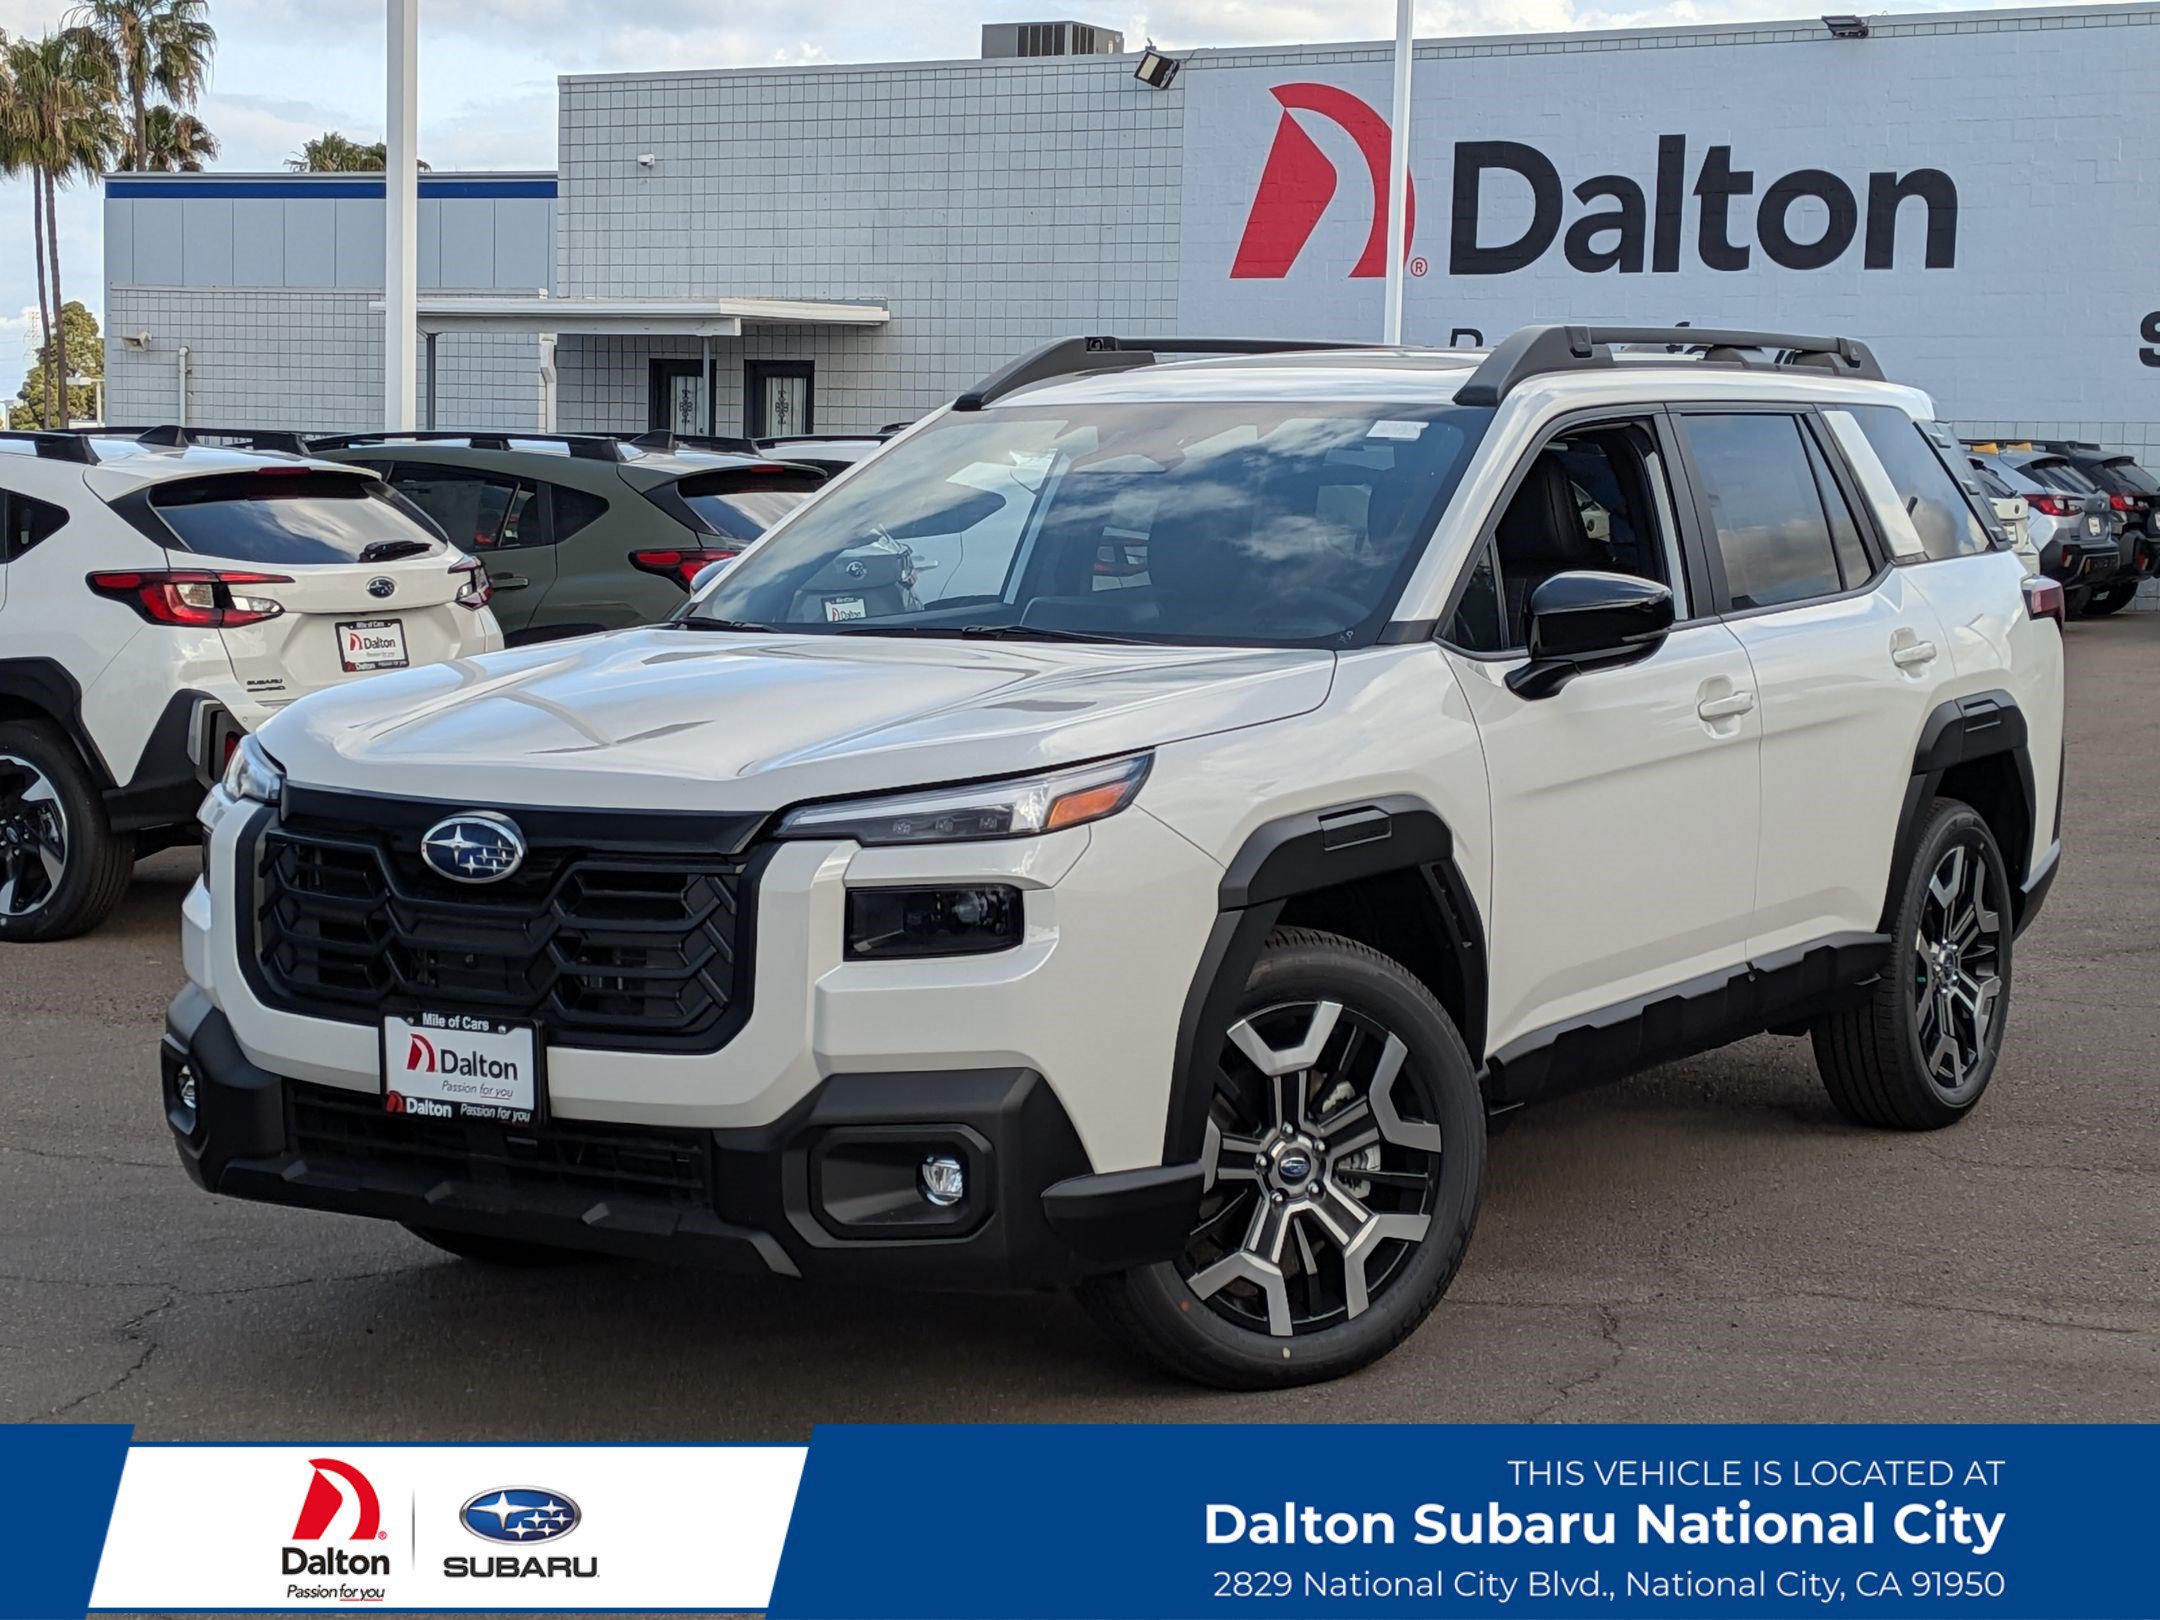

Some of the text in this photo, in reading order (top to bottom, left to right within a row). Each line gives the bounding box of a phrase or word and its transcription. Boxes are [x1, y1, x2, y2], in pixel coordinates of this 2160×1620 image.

[1449, 134, 1958, 275] Dalton
[363, 636, 396, 649] Dalton
[422, 1012, 489, 1031] Mile of Cars
[440, 1048, 518, 1081] Dalton
[441, 1080, 514, 1098] Passion for you
[406, 1098, 531, 1123] Dalton Passion for you
